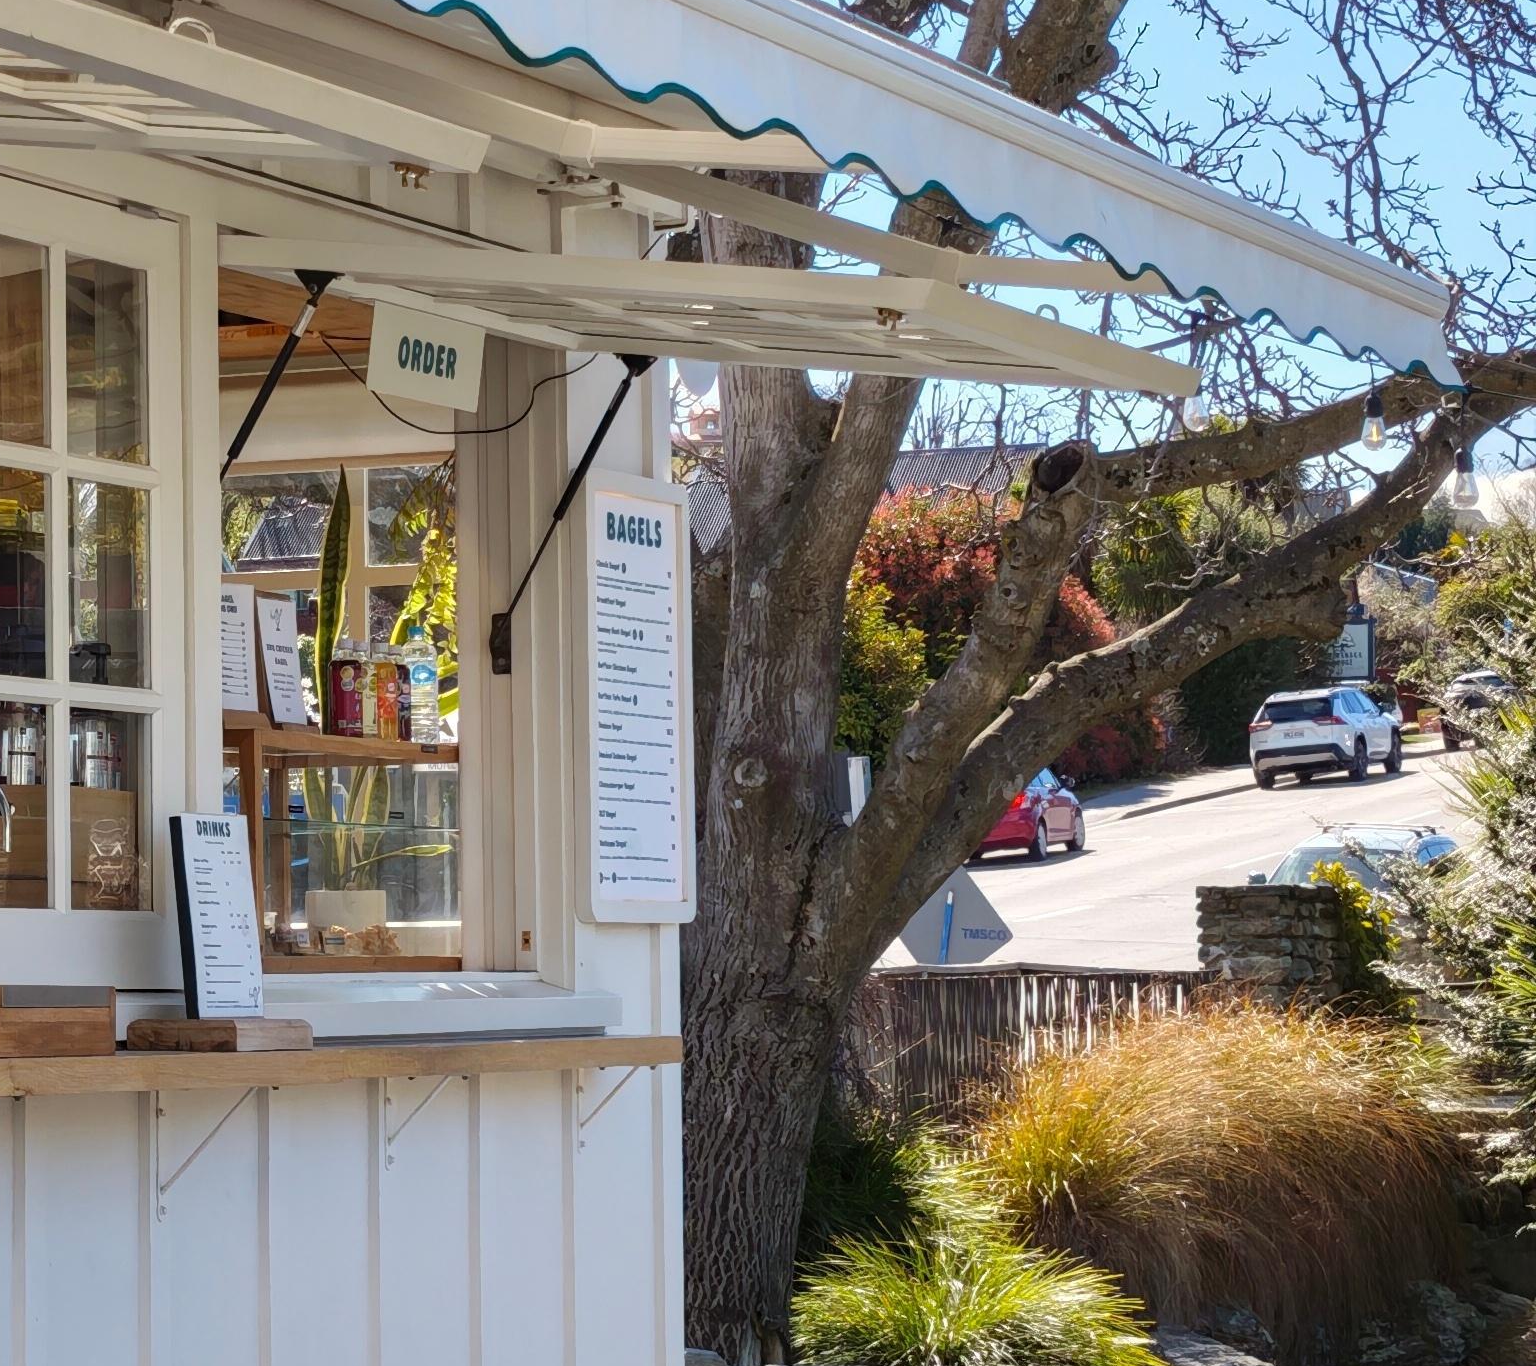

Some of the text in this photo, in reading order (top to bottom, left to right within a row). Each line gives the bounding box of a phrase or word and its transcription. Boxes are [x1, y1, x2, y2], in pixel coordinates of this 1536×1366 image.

[397, 335, 457, 381] ORDER
[606, 511, 663, 549] BAGELS
[195, 819, 231, 838] DRINKS
[960, 927, 1008, 941] TMSCO
